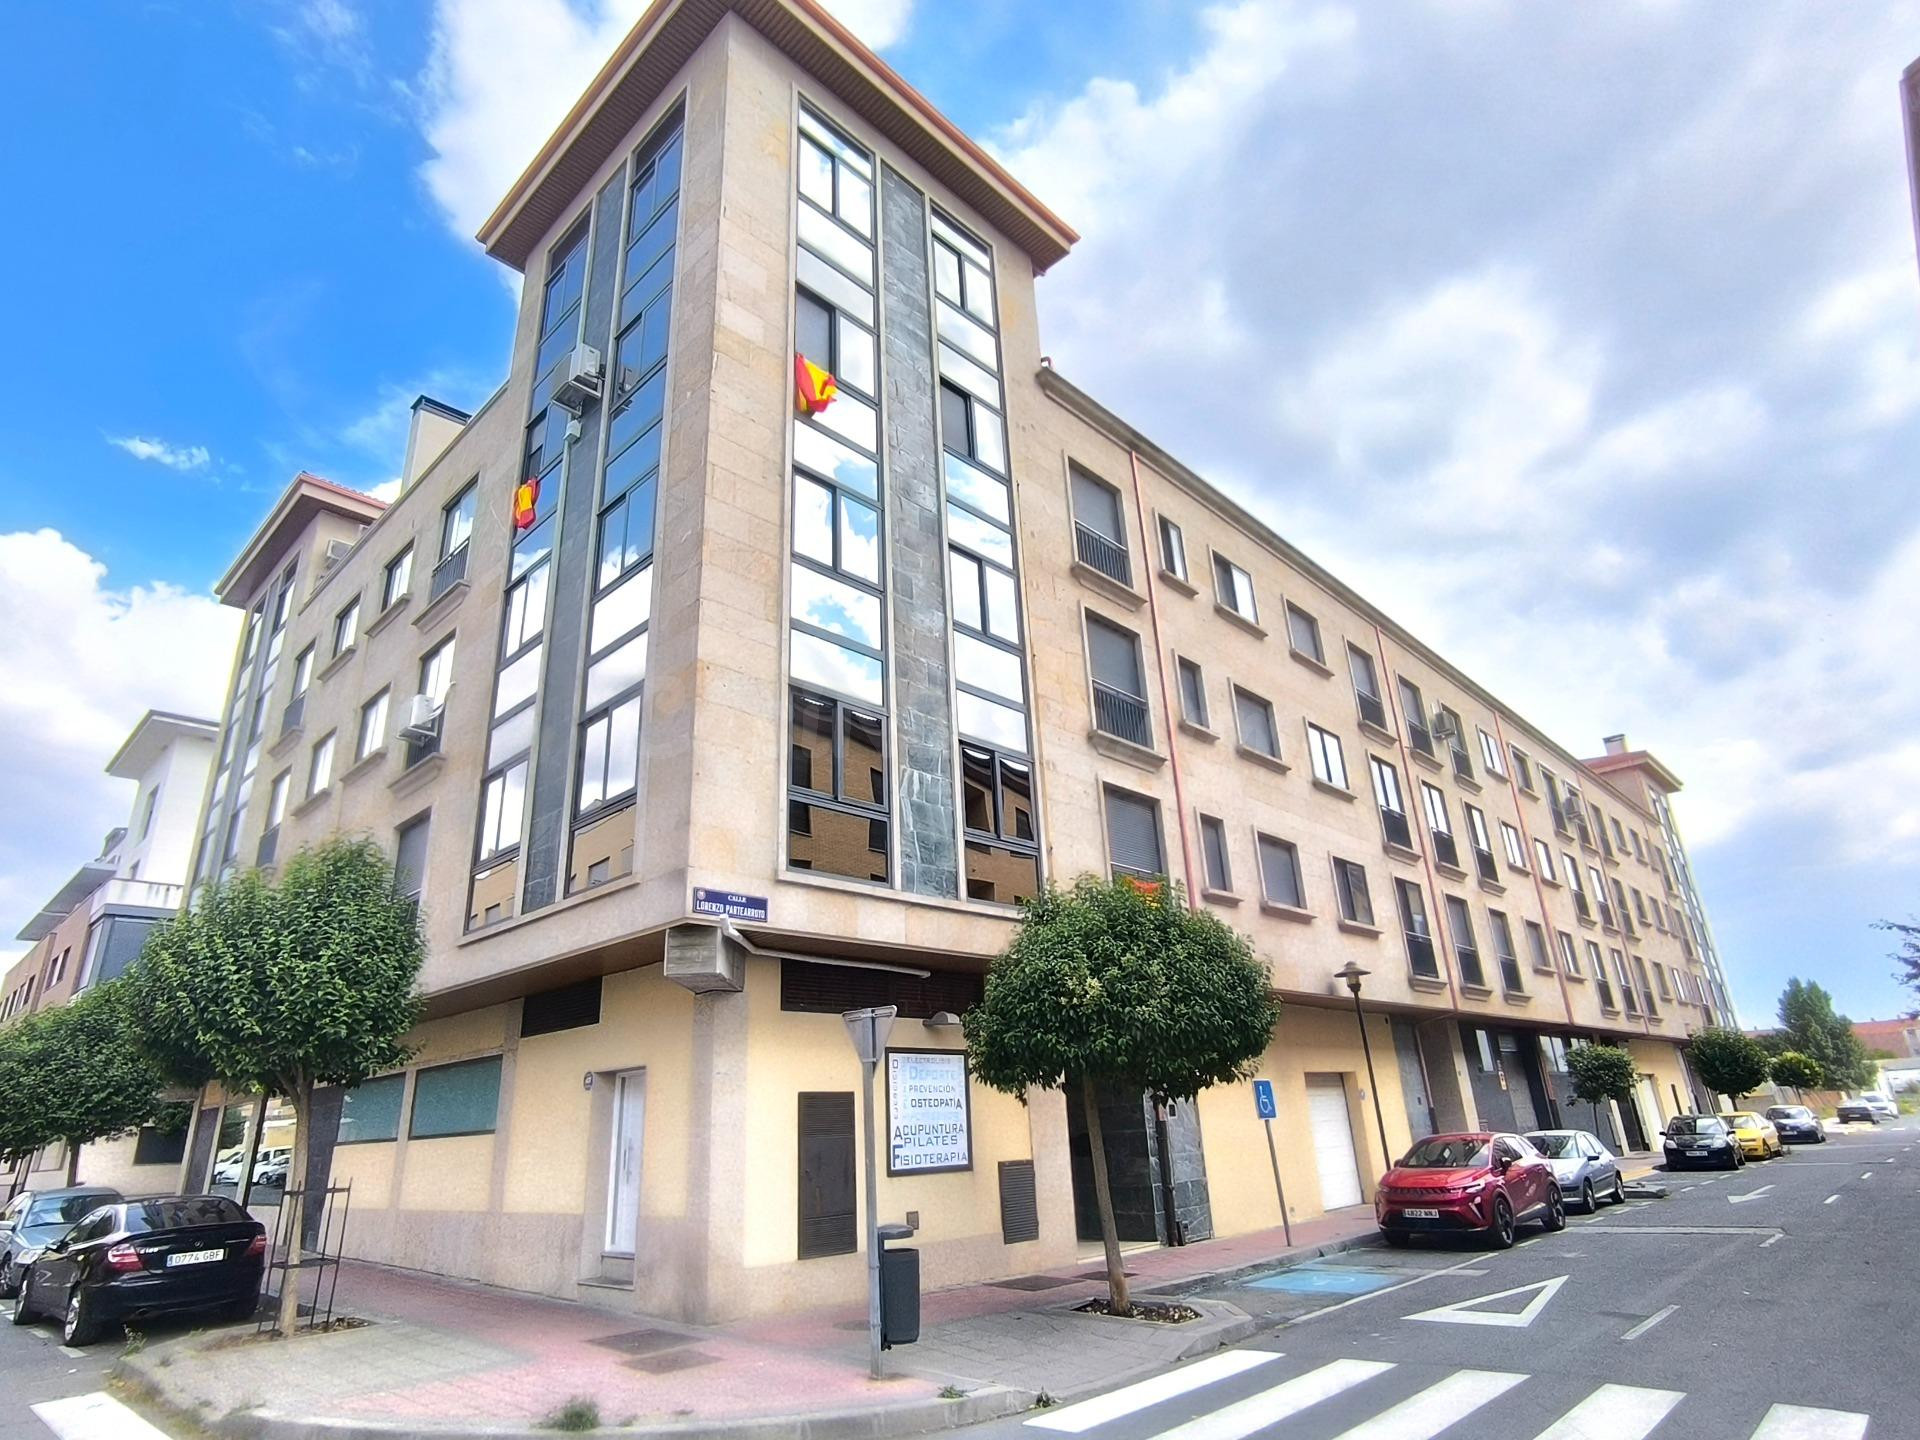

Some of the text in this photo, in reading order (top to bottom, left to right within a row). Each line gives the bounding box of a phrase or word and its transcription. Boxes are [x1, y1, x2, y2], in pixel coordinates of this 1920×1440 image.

[728, 895, 746, 903] CALLE
[696, 900, 765, 918] LORENZO PARTEARROYO
[909, 1083, 956, 1094] PREVENCIÓN
[894, 1123, 964, 1141] ACUPUNTURA
[904, 1135, 958, 1148] PILATES
[892, 1144, 968, 1168] FISIOTERAPIA
[175, 1250, 220, 1264] 0774 GBF
